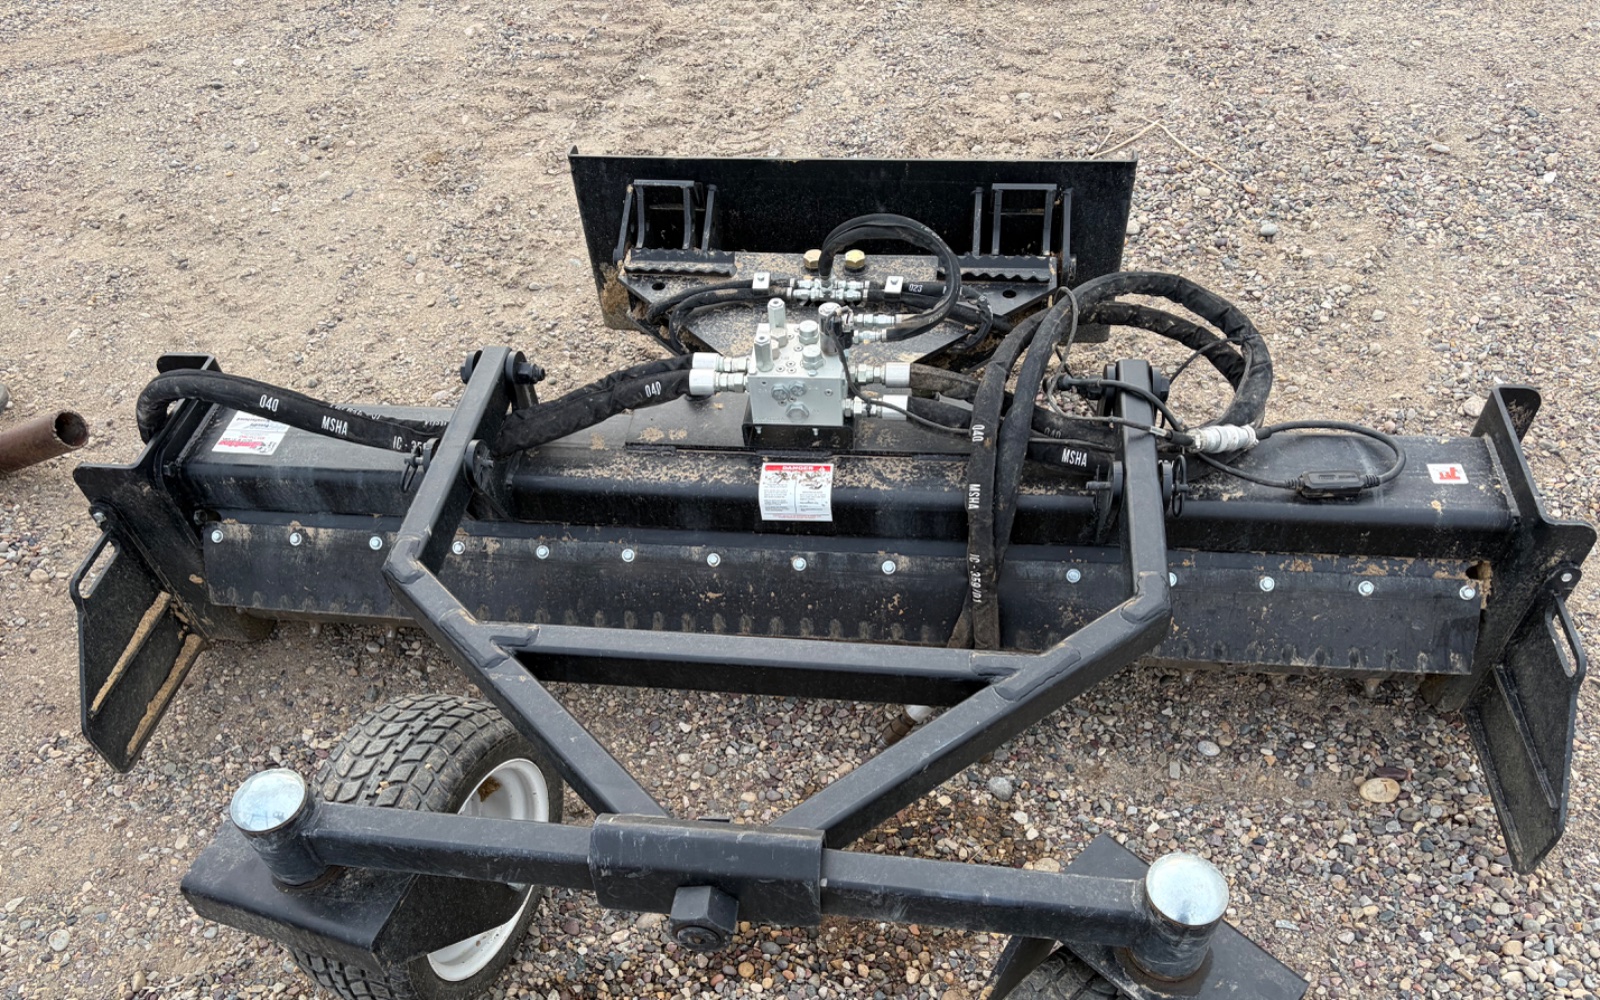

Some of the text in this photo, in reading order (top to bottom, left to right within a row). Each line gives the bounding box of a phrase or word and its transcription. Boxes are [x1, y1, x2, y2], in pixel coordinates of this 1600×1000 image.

[908, 283, 923, 293] 023
[645, 381, 661, 398] 040
[260, 394, 279, 412] 040
[321, 415, 348, 436] MSHA
[392, 436, 402, 450] IC
[972, 424, 985, 442] 040
[1061, 447, 1088, 468] MSHA
[968, 484, 981, 510] MSHA
